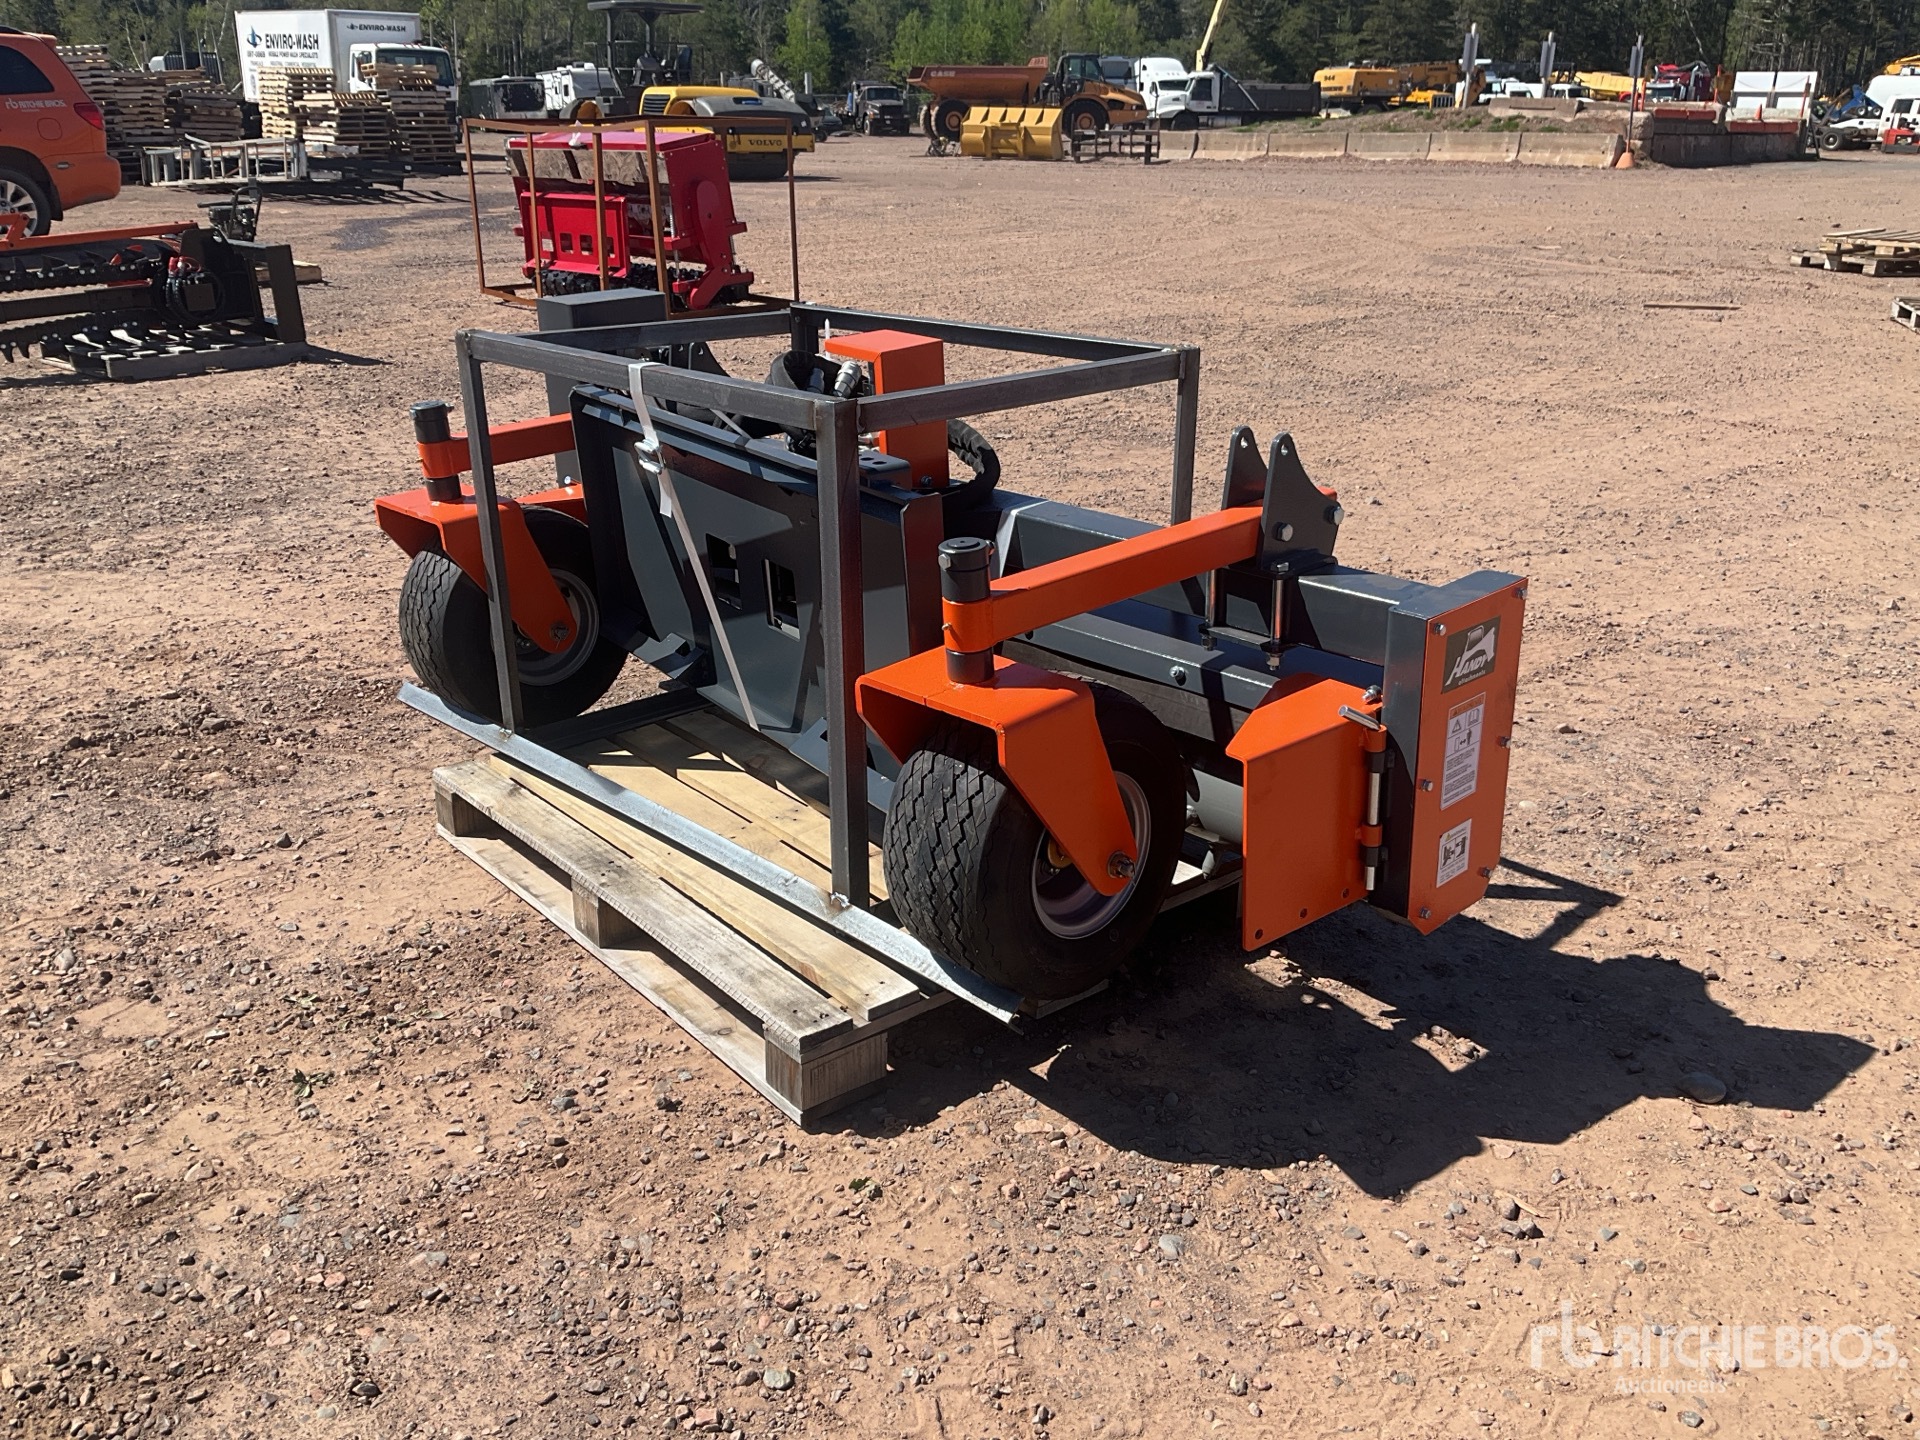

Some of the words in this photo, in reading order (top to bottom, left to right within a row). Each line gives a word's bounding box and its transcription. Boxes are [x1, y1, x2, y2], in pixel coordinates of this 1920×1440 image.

[359, 24, 406, 32] ENVIRO-WASH
[265, 33, 319, 50] ENVIRO-WASH
[1445, 653, 1488, 686] HANDY
